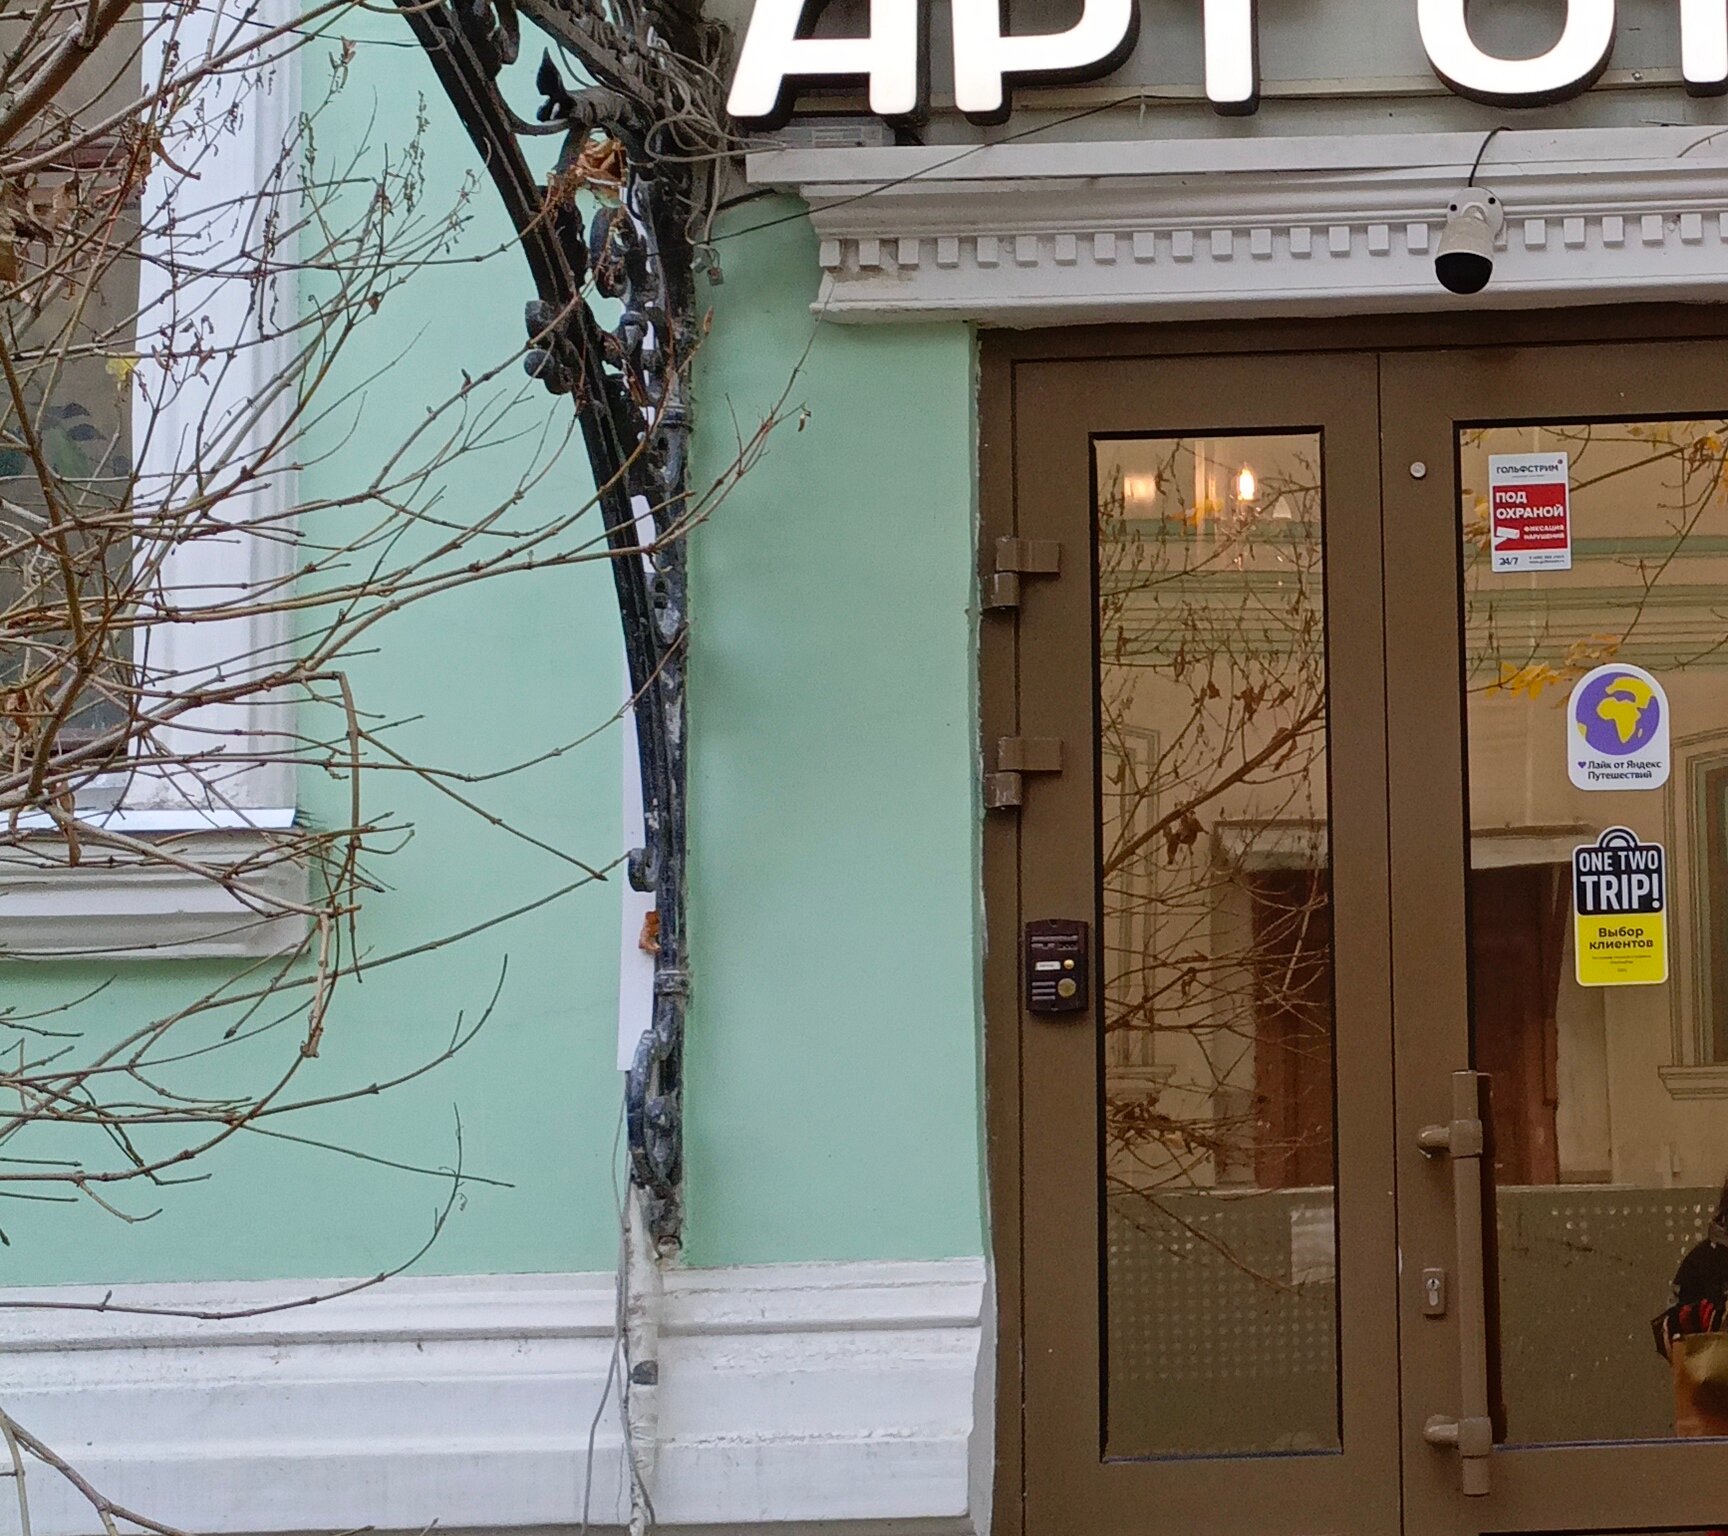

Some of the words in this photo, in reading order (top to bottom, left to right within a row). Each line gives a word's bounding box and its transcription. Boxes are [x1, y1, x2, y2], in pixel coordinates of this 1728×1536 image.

[1496, 464, 1559, 474] ГОЛЬФСТРИМ
[1495, 491, 1528, 504] ПОД
[1496, 504, 1564, 520] ОХРАНОЙ
[1499, 557, 1519, 566] 24/7
[1587, 760, 1612, 770] Лайк
[1613, 761, 1625, 769] от
[1626, 760, 1662, 770] Яндекс
[1587, 770, 1653, 782] Путешествий
[1579, 851, 1614, 872] ONE
[1617, 850, 1660, 871] TWO
[1580, 873, 1660, 911] TRIP!
[1598, 926, 1644, 939] Выбор
[1589, 938, 1654, 950] клиентов
